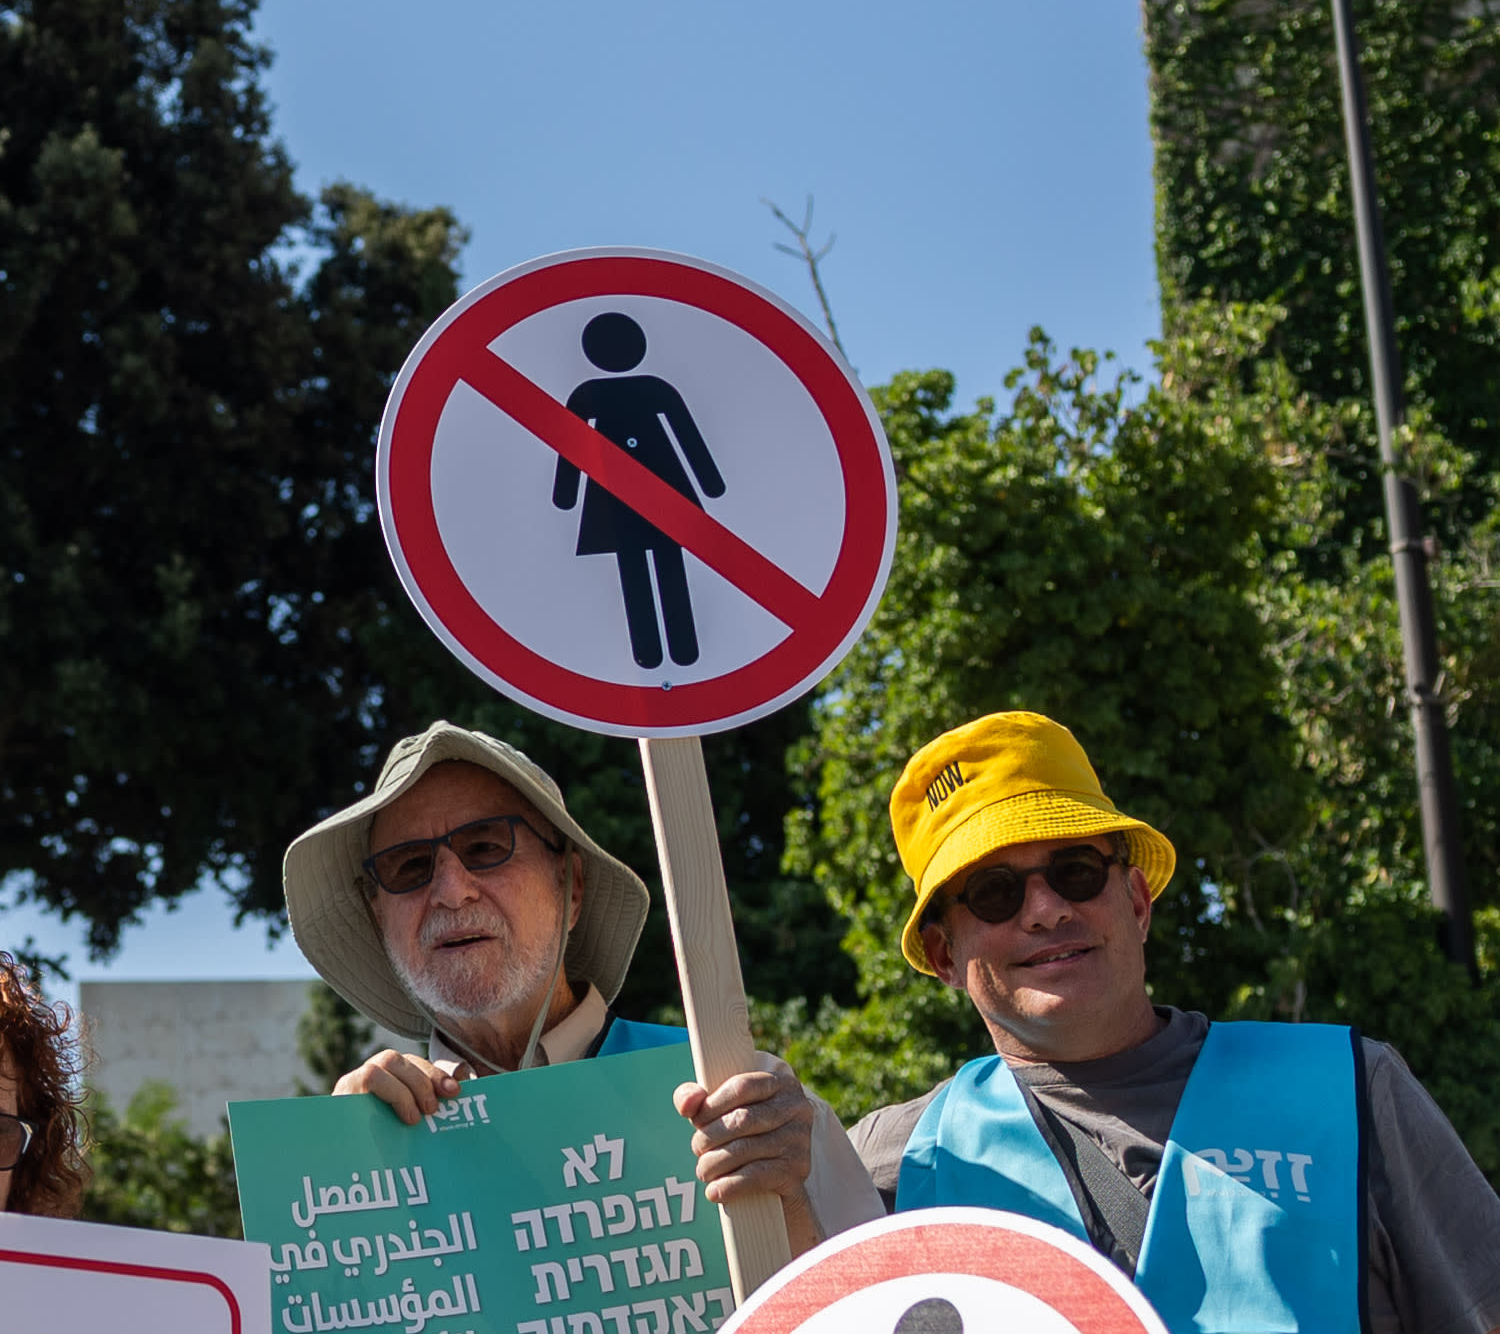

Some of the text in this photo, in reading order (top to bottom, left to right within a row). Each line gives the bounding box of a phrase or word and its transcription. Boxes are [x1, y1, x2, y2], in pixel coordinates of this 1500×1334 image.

[561, 1133, 625, 1188] לא
[291, 1165, 430, 1229] لا للفصل
[511, 1176, 696, 1252] להפרדה
[332, 1211, 478, 1278] الجندري
[531, 1238, 704, 1304] מגדרית
[281, 1273, 482, 1334] المؤسسات
